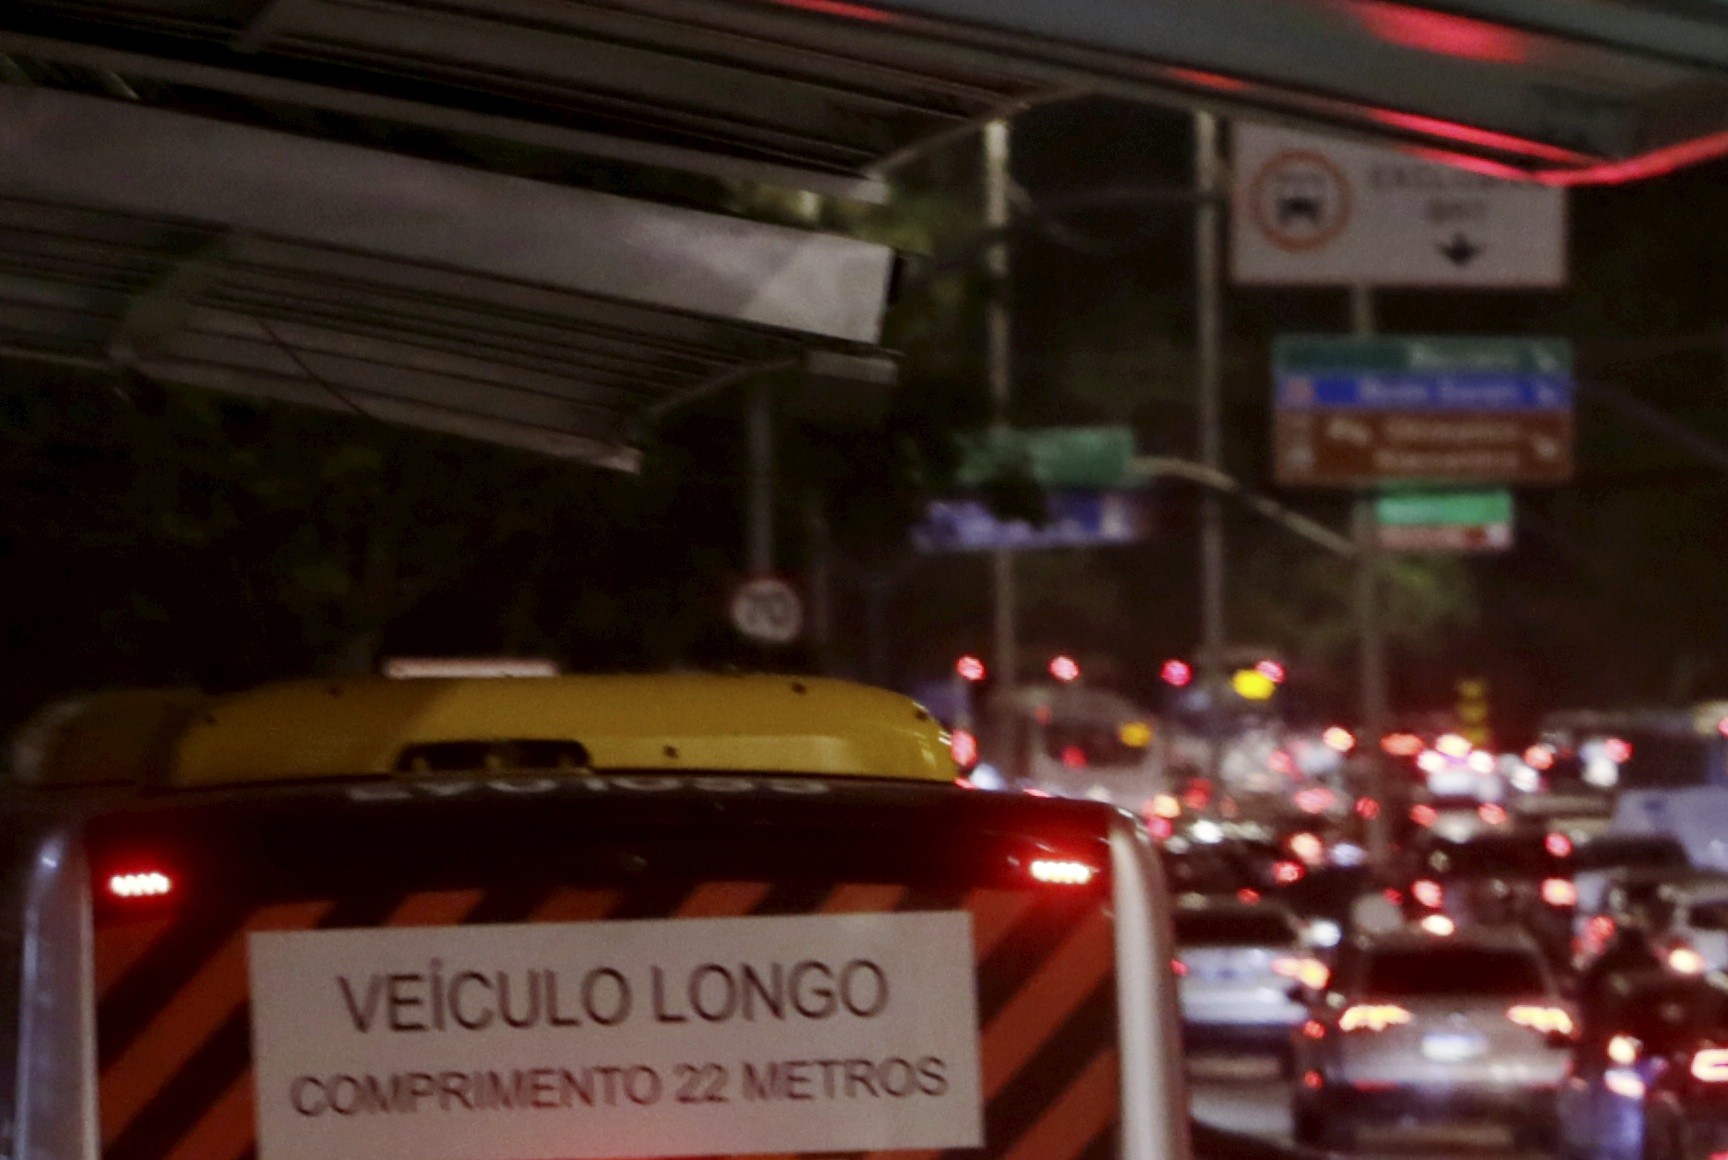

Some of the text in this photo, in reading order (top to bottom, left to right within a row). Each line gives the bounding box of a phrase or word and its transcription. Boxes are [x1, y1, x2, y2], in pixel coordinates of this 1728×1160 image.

[336, 956, 889, 1034] VEÍCULO LONGO
[290, 1055, 950, 1118] COMPRIMENTO 22 METROS
